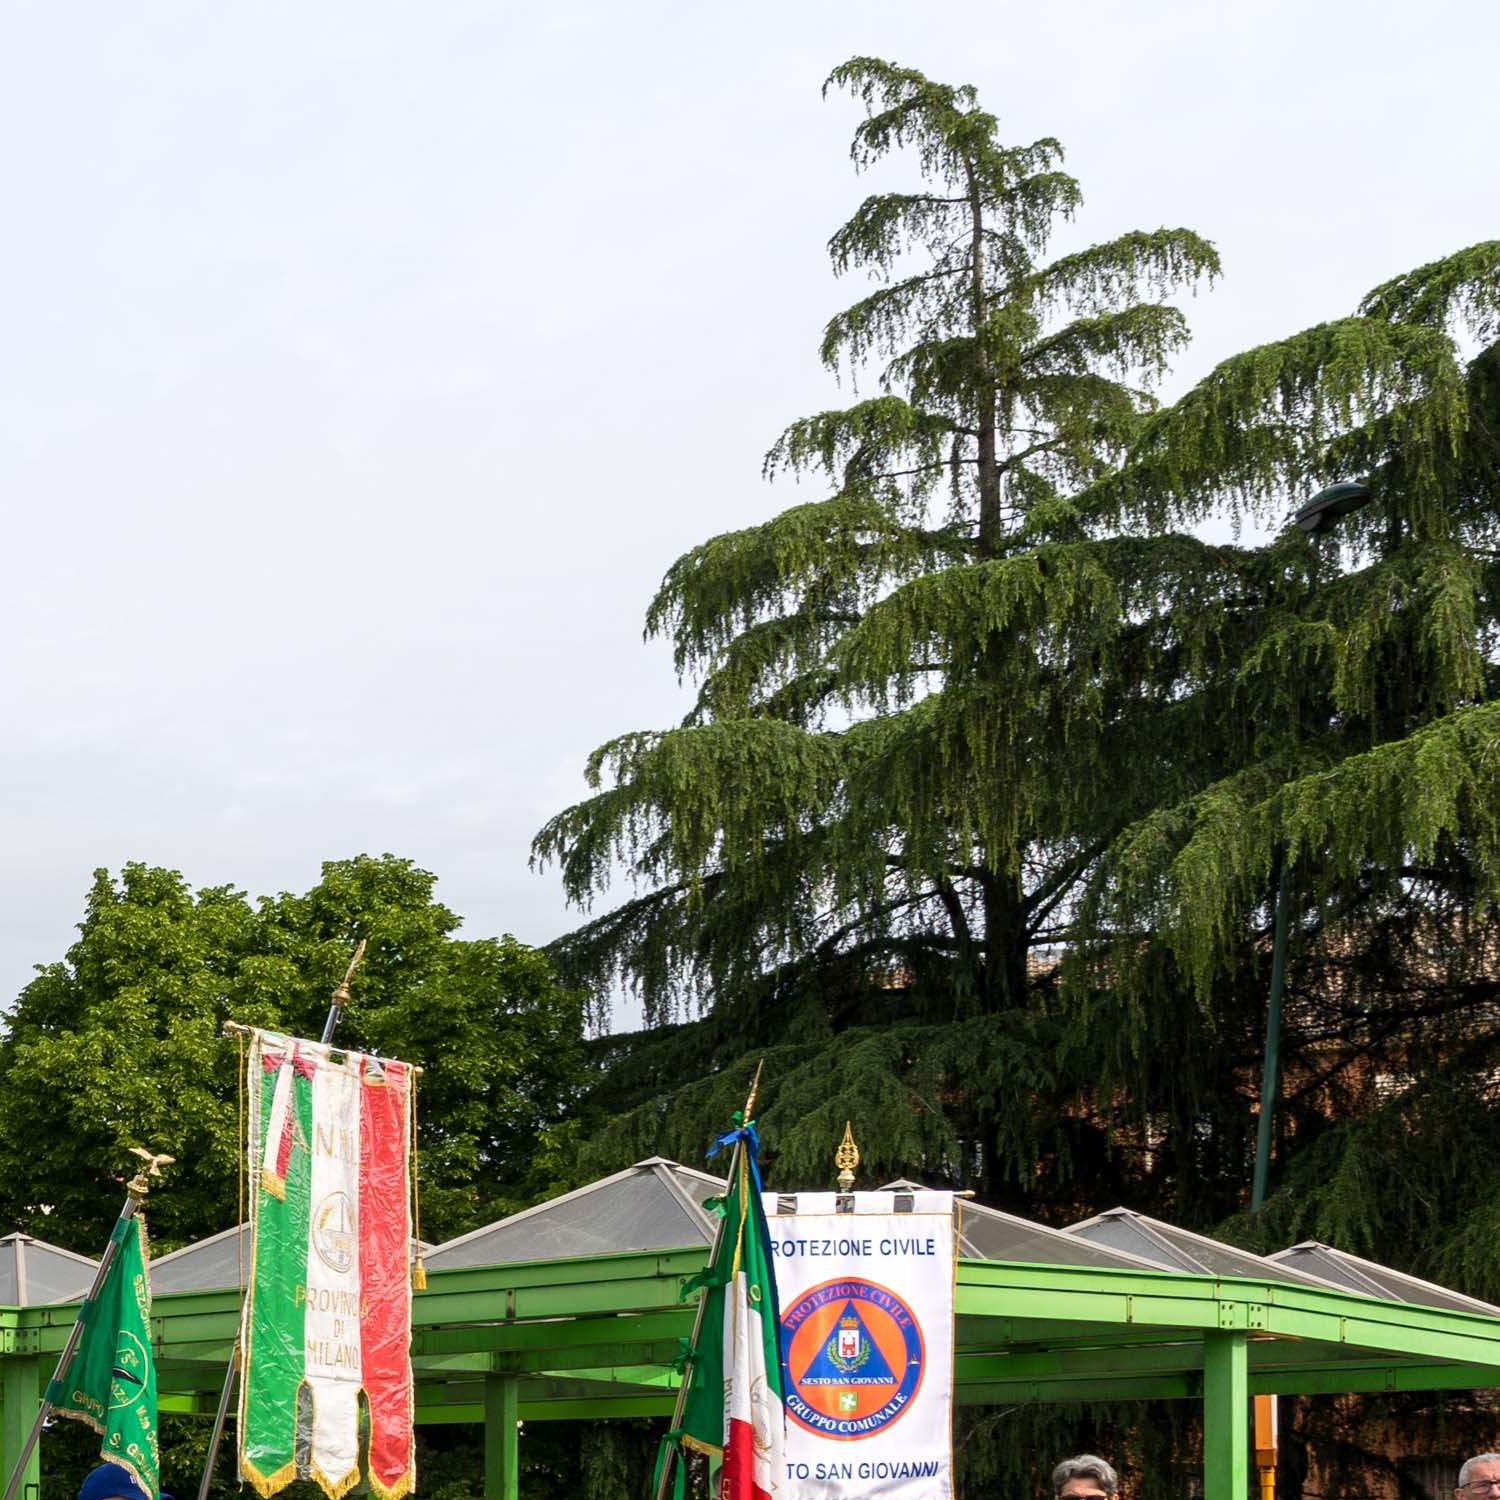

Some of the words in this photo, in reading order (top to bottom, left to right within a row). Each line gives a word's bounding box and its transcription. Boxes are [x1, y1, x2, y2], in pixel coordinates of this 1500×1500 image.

[771, 1239, 873, 1258] ROTEZIONE
[879, 1238, 936, 1256] CIVILE
[784, 1284, 868, 1330] PROTEZIONE
[869, 1288, 914, 1330] CIVILE
[306, 1339, 360, 1370] MILANO
[801, 1376, 832, 1386] SESTO
[832, 1376, 850, 1386] SAN
[850, 1376, 894, 1386] GIOVANNI
[785, 1393, 837, 1431] GRUPPO
[838, 1391, 908, 1433] COMUNALE
[786, 1462, 810, 1480] TO
[815, 1462, 852, 1480] SAN
[858, 1461, 939, 1480] GIOVANNI
